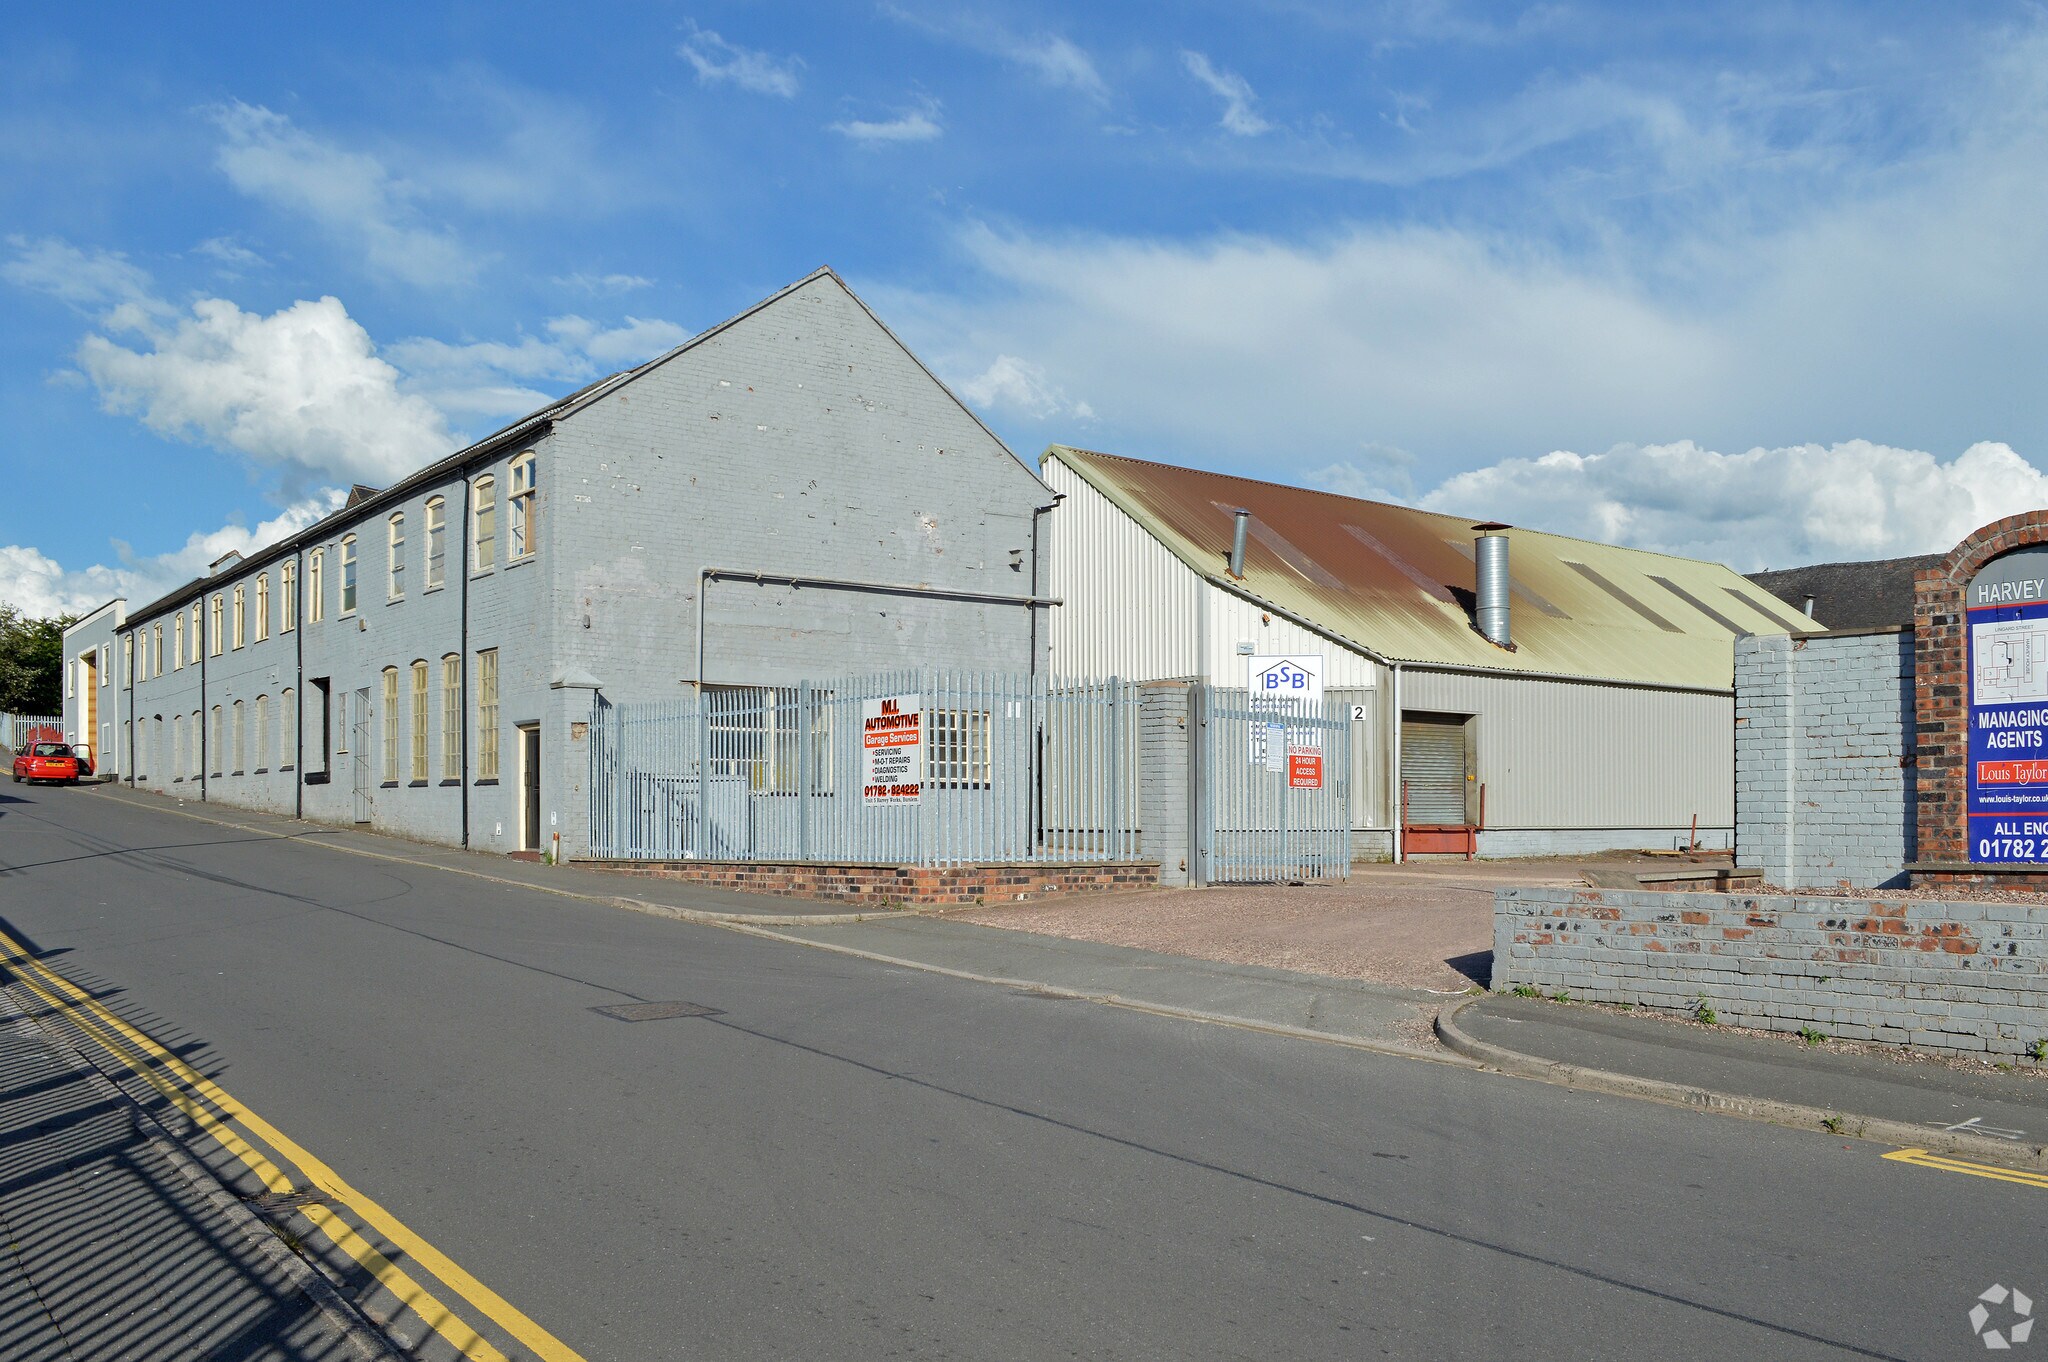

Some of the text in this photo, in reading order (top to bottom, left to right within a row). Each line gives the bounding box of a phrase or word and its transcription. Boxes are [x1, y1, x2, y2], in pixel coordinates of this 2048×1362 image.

[1978, 578, 2045, 604] HARVEY
[2015, 624, 2034, 632] STREET
[1266, 666, 1305, 689] BSB
[881, 698, 900, 716] M.I.
[1354, 707, 1363, 720] 2
[864, 713, 919, 732] AUTOMOTIVE
[1979, 709, 2048, 729] MANAGING
[866, 732, 917, 746] Garage Services
[1987, 730, 2043, 749] AGENTS
[875, 748, 902, 757] SERVICING
[1289, 746, 1322, 756] NO PARKING
[889, 756, 911, 765] REPAIRS
[1295, 757, 1316, 766] 24 HOUR
[874, 765, 908, 775] DIAGNOSTICS
[1295, 767, 1316, 776] ACCESS
[1981, 763, 2047, 785] Louis Taylor
[875, 775, 898, 783] WELDING
[1293, 777, 1319, 787] REQUIRED
[1994, 822, 2021, 836] ALL
[1979, 838, 2035, 859] 01782
